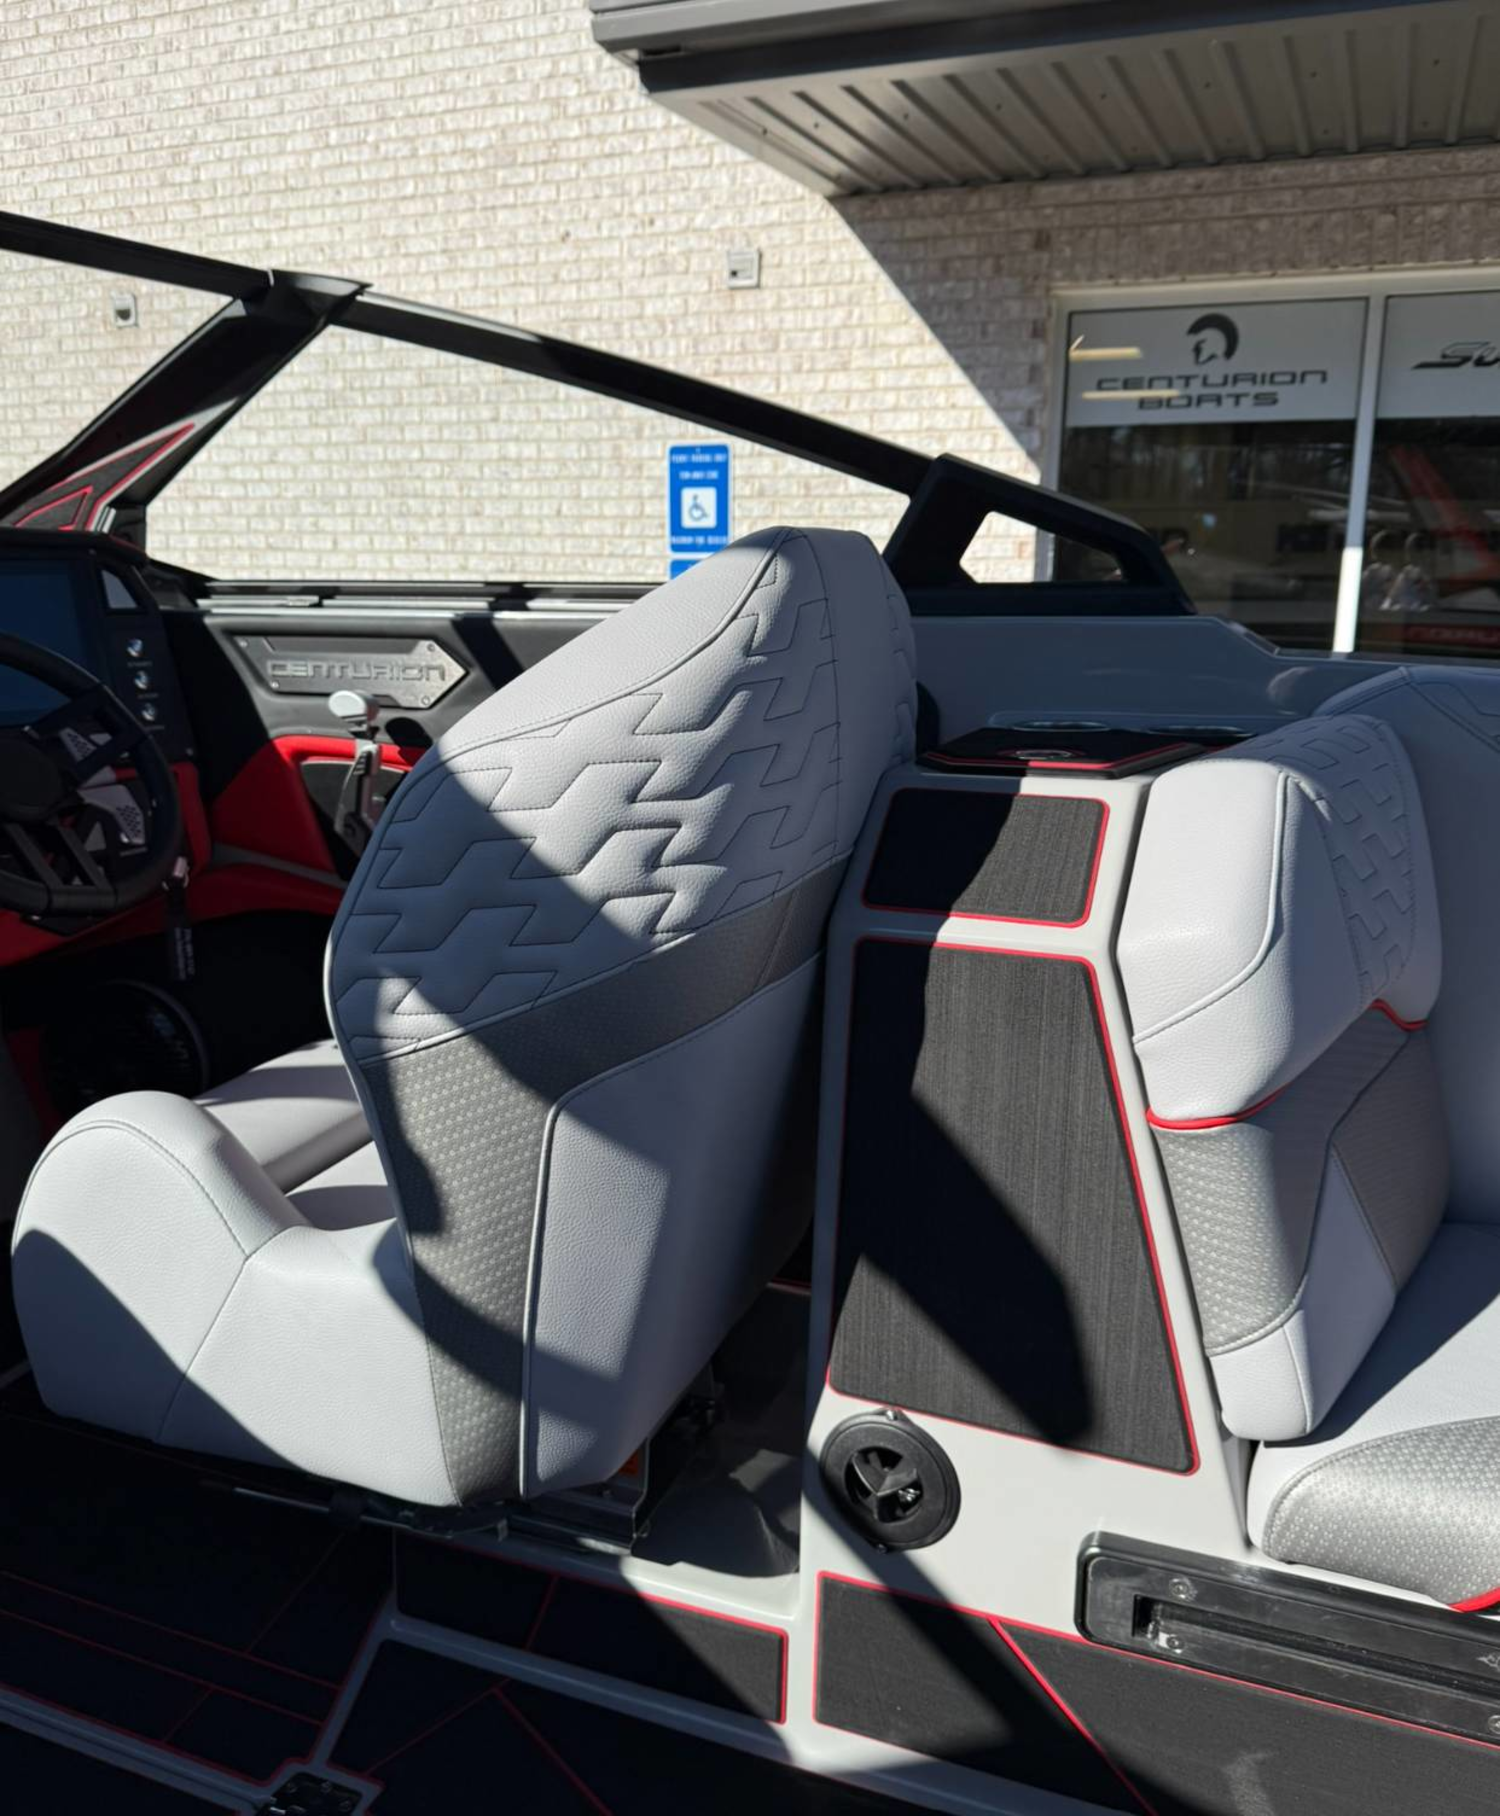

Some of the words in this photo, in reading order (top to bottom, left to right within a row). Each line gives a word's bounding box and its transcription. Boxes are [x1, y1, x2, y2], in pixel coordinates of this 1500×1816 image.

[1096, 369, 1328, 391] CENTURION
[1137, 391, 1279, 410] BOATS
[267, 659, 447, 681] CENTURION
